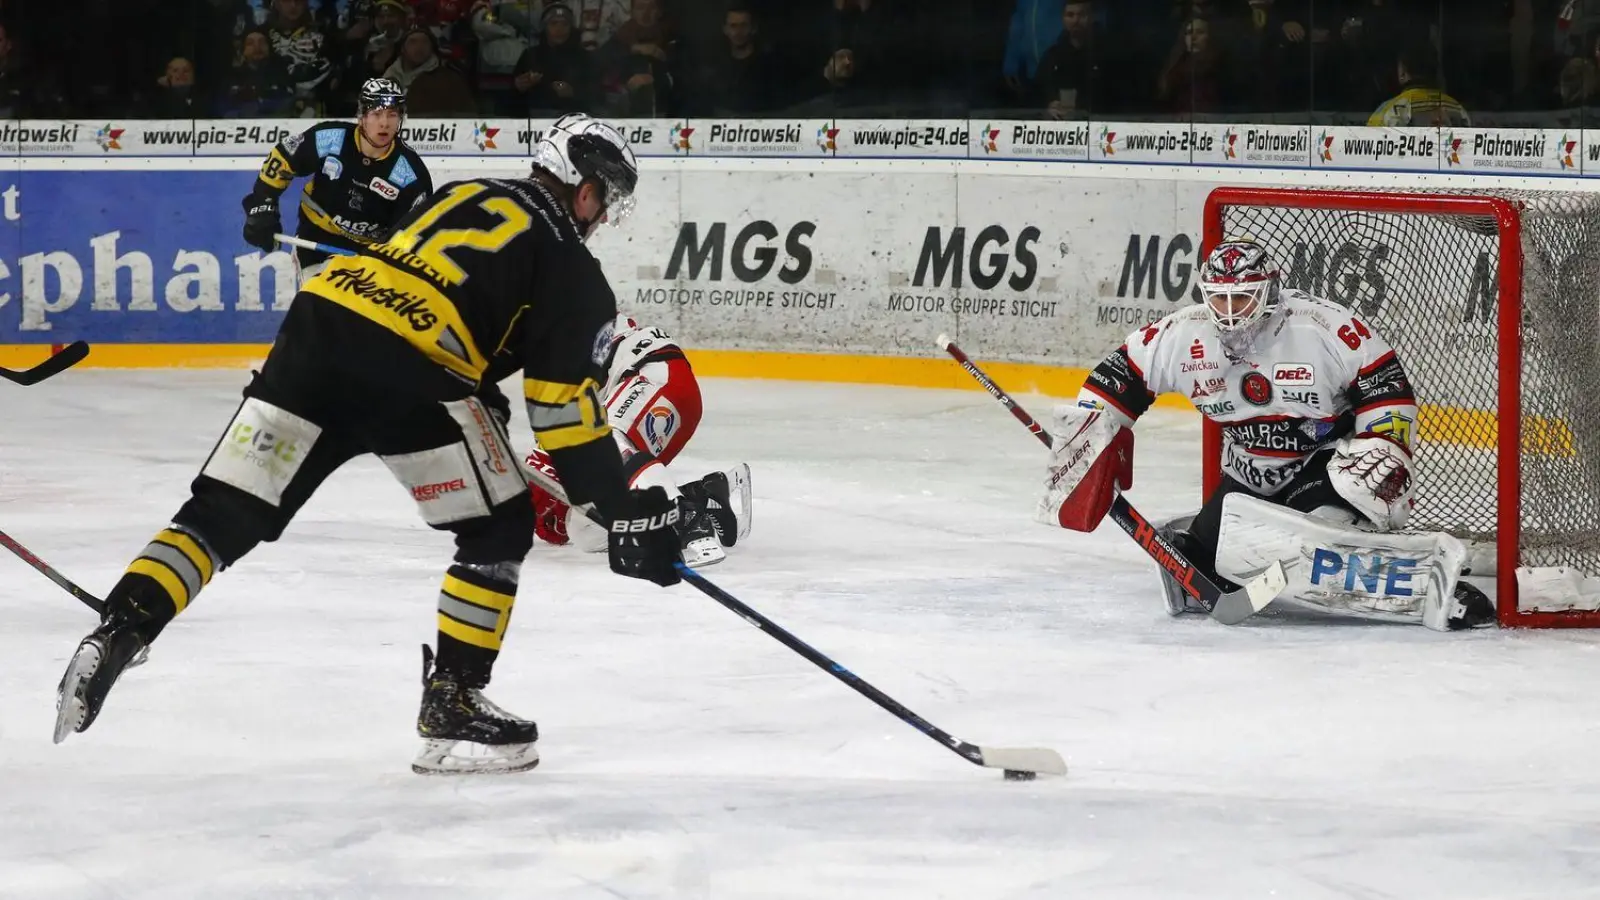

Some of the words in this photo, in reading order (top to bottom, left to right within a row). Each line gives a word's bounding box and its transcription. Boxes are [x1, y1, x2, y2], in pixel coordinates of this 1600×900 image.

[709, 123, 802, 143] Piotrowski
[853, 126, 968, 149] www.pio-24.de
[1012, 125, 1088, 146] Piotrowski
[1126, 131, 1213, 154] www.pio-24.de
[1246, 130, 1308, 152] Piotrowski
[1343, 135, 1434, 160] www.pio-24.de
[1473, 133, 1546, 158] Piotrowski
[249, 203, 276, 215] BAU
[400, 181, 532, 286] 12
[664, 220, 816, 284] MGS
[912, 225, 1041, 291] MGS
[0, 230, 300, 331] phan
[636, 289, 701, 305] MOTOR
[710, 290, 774, 307] GRUPPE
[781, 292, 836, 308] STICHT
[888, 295, 944, 313] MOTOR
[950, 298, 1005, 316] GRUPPE
[1011, 300, 1057, 317] STICHT
[1097, 306, 1143, 325] MOTOR
[1337, 317, 1372, 350] 64
[1181, 360, 1219, 373] Zwickau
[614, 389, 641, 418] LENDEX
[411, 478, 467, 498] HERTEL
[1127, 507, 1200, 599] HEMPEL
[1154, 534, 1187, 568] autohaus
[1311, 547, 1416, 597] PNE
